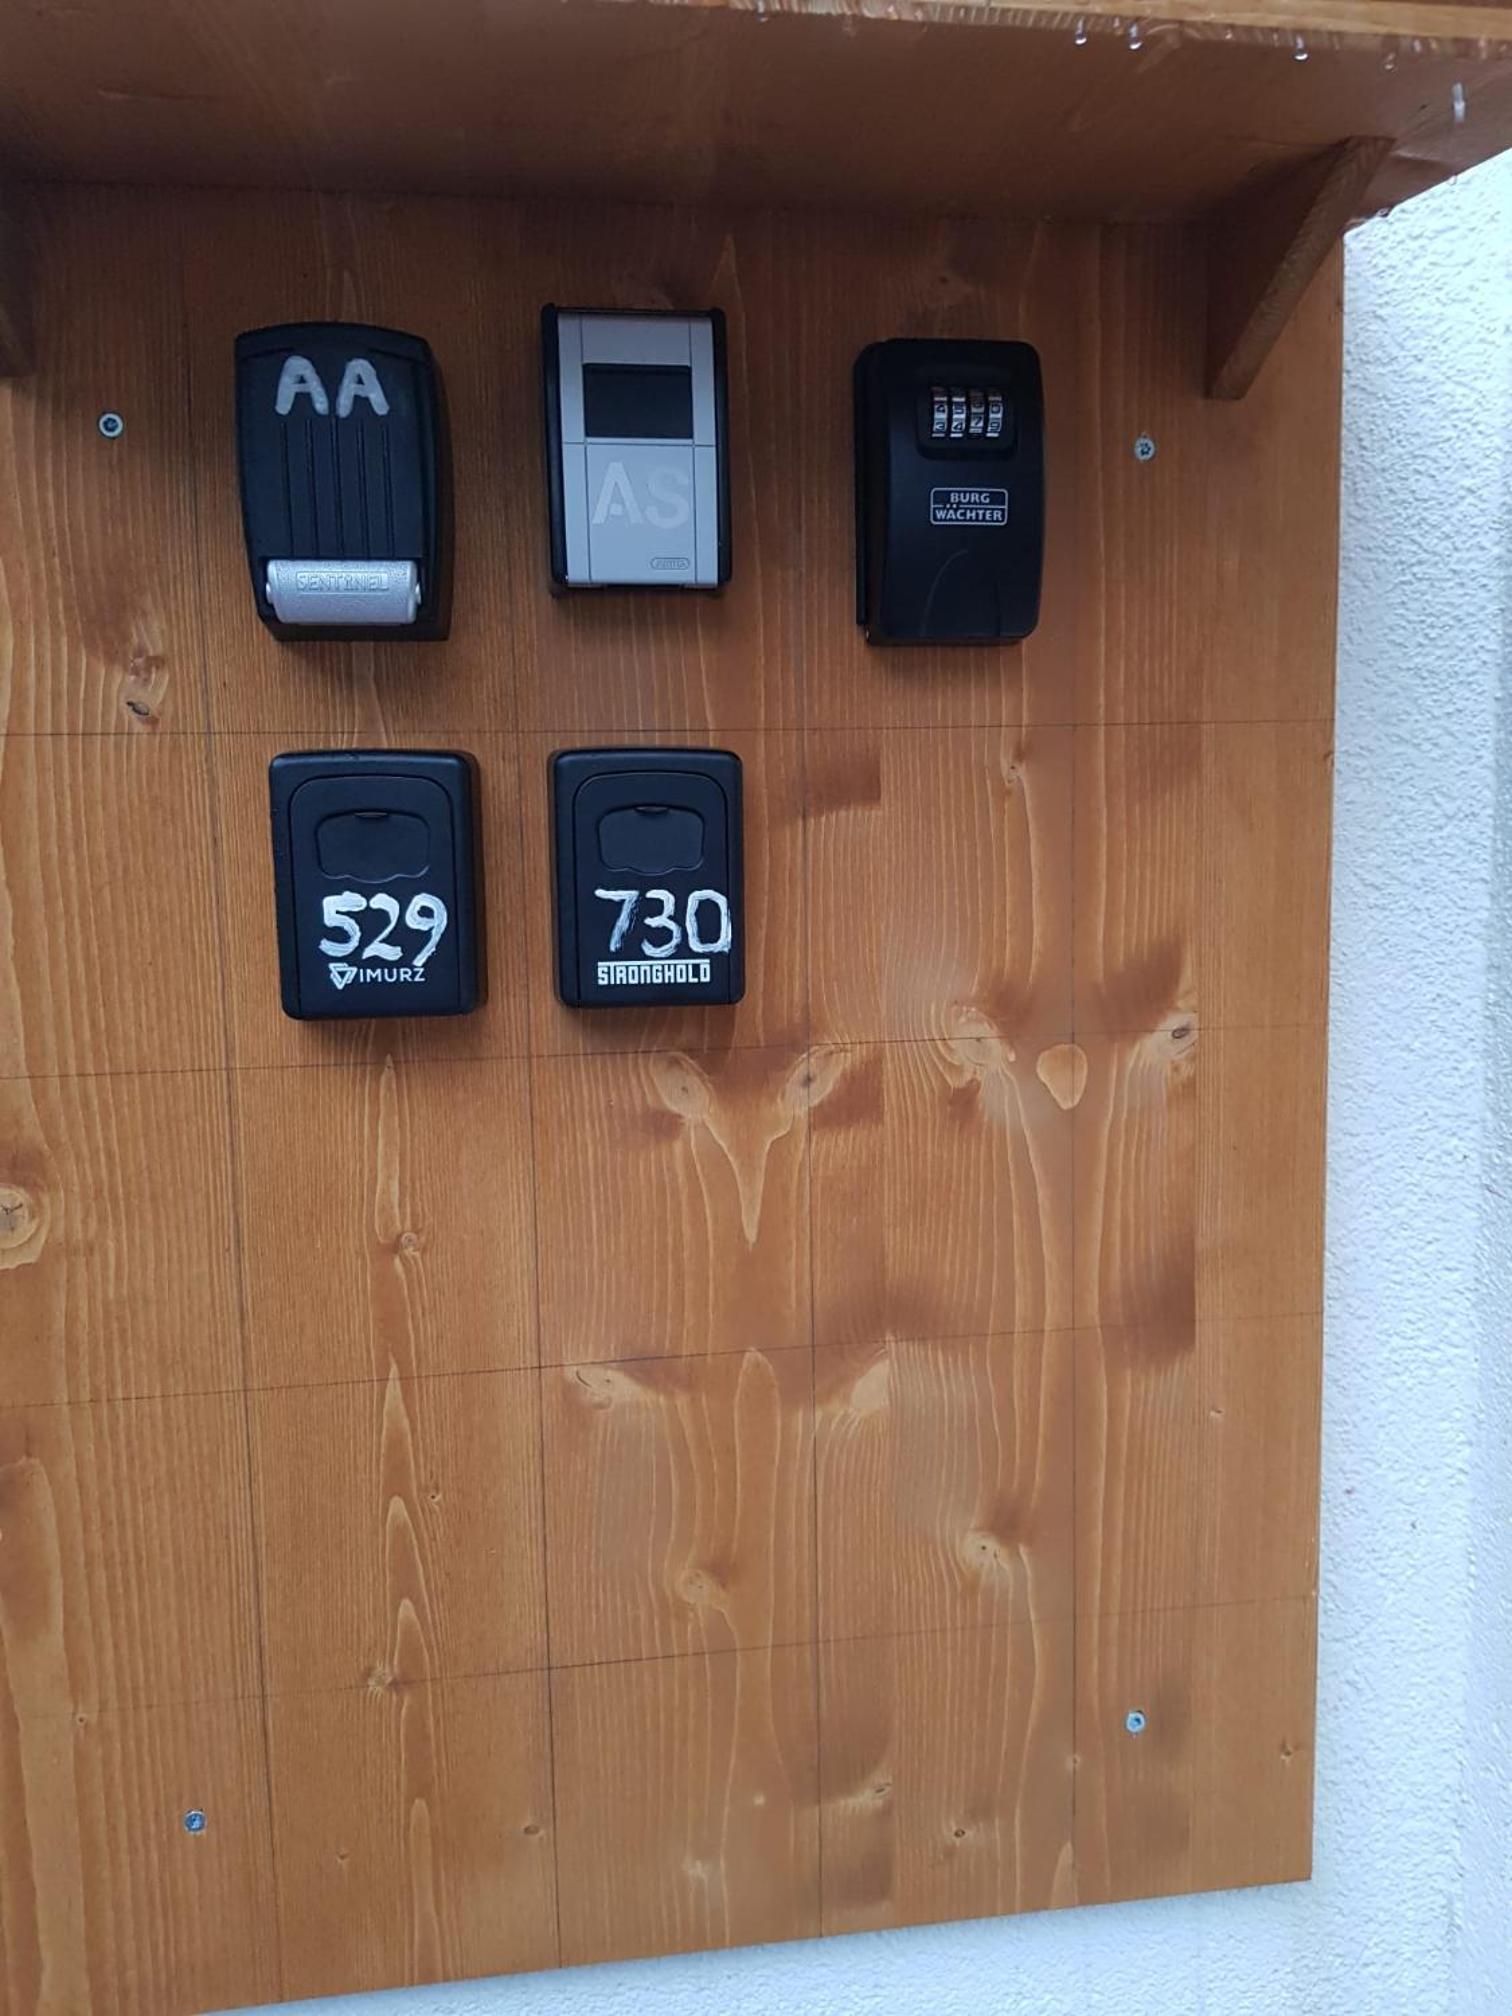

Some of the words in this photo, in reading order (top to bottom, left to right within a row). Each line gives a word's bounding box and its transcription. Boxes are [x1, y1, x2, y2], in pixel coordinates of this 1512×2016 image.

[275, 355, 390, 418] AA
[592, 461, 690, 529] AS
[936, 504, 1002, 521] WÄCHTER
[950, 492, 990, 503] BURG
[297, 573, 389, 591] SENTINEL
[319, 891, 448, 967] 529
[595, 889, 732, 958] 730
[598, 959, 711, 985] STRONGHOLD
